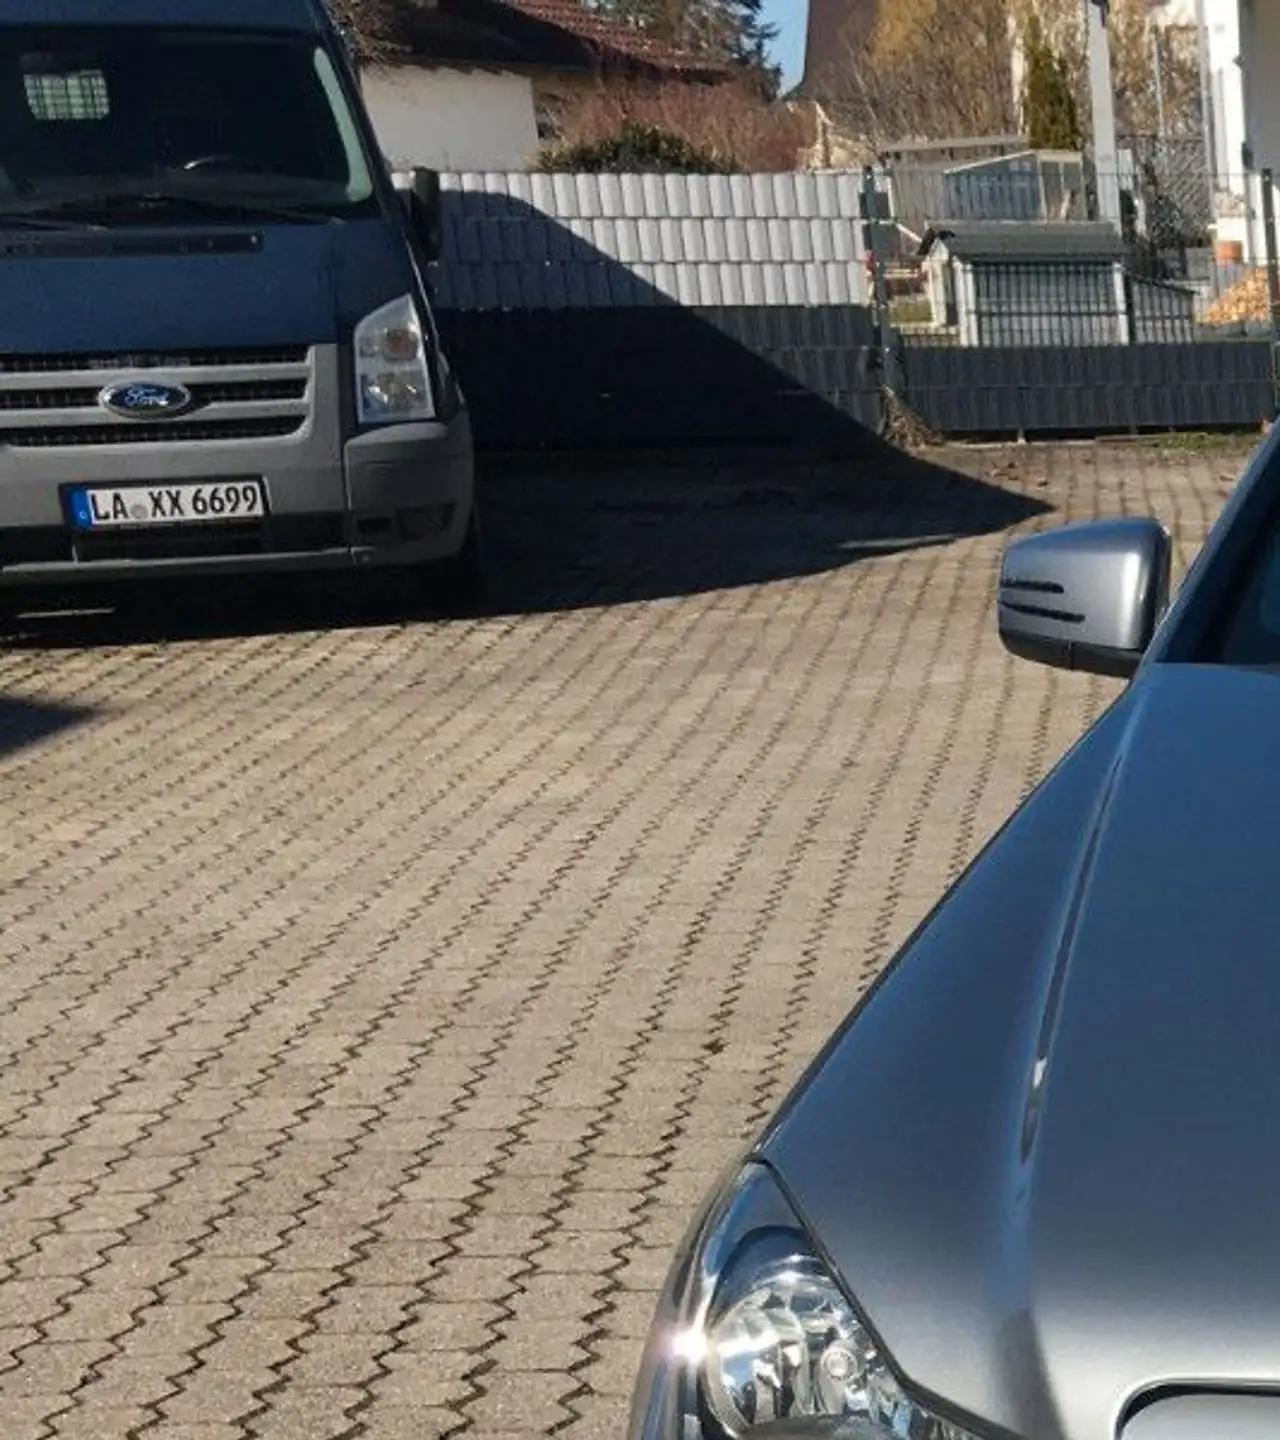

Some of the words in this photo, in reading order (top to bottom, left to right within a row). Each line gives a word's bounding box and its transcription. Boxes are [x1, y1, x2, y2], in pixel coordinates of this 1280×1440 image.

[91, 492, 129, 520] LA
[148, 489, 185, 518] XX
[192, 485, 258, 515] 6699
